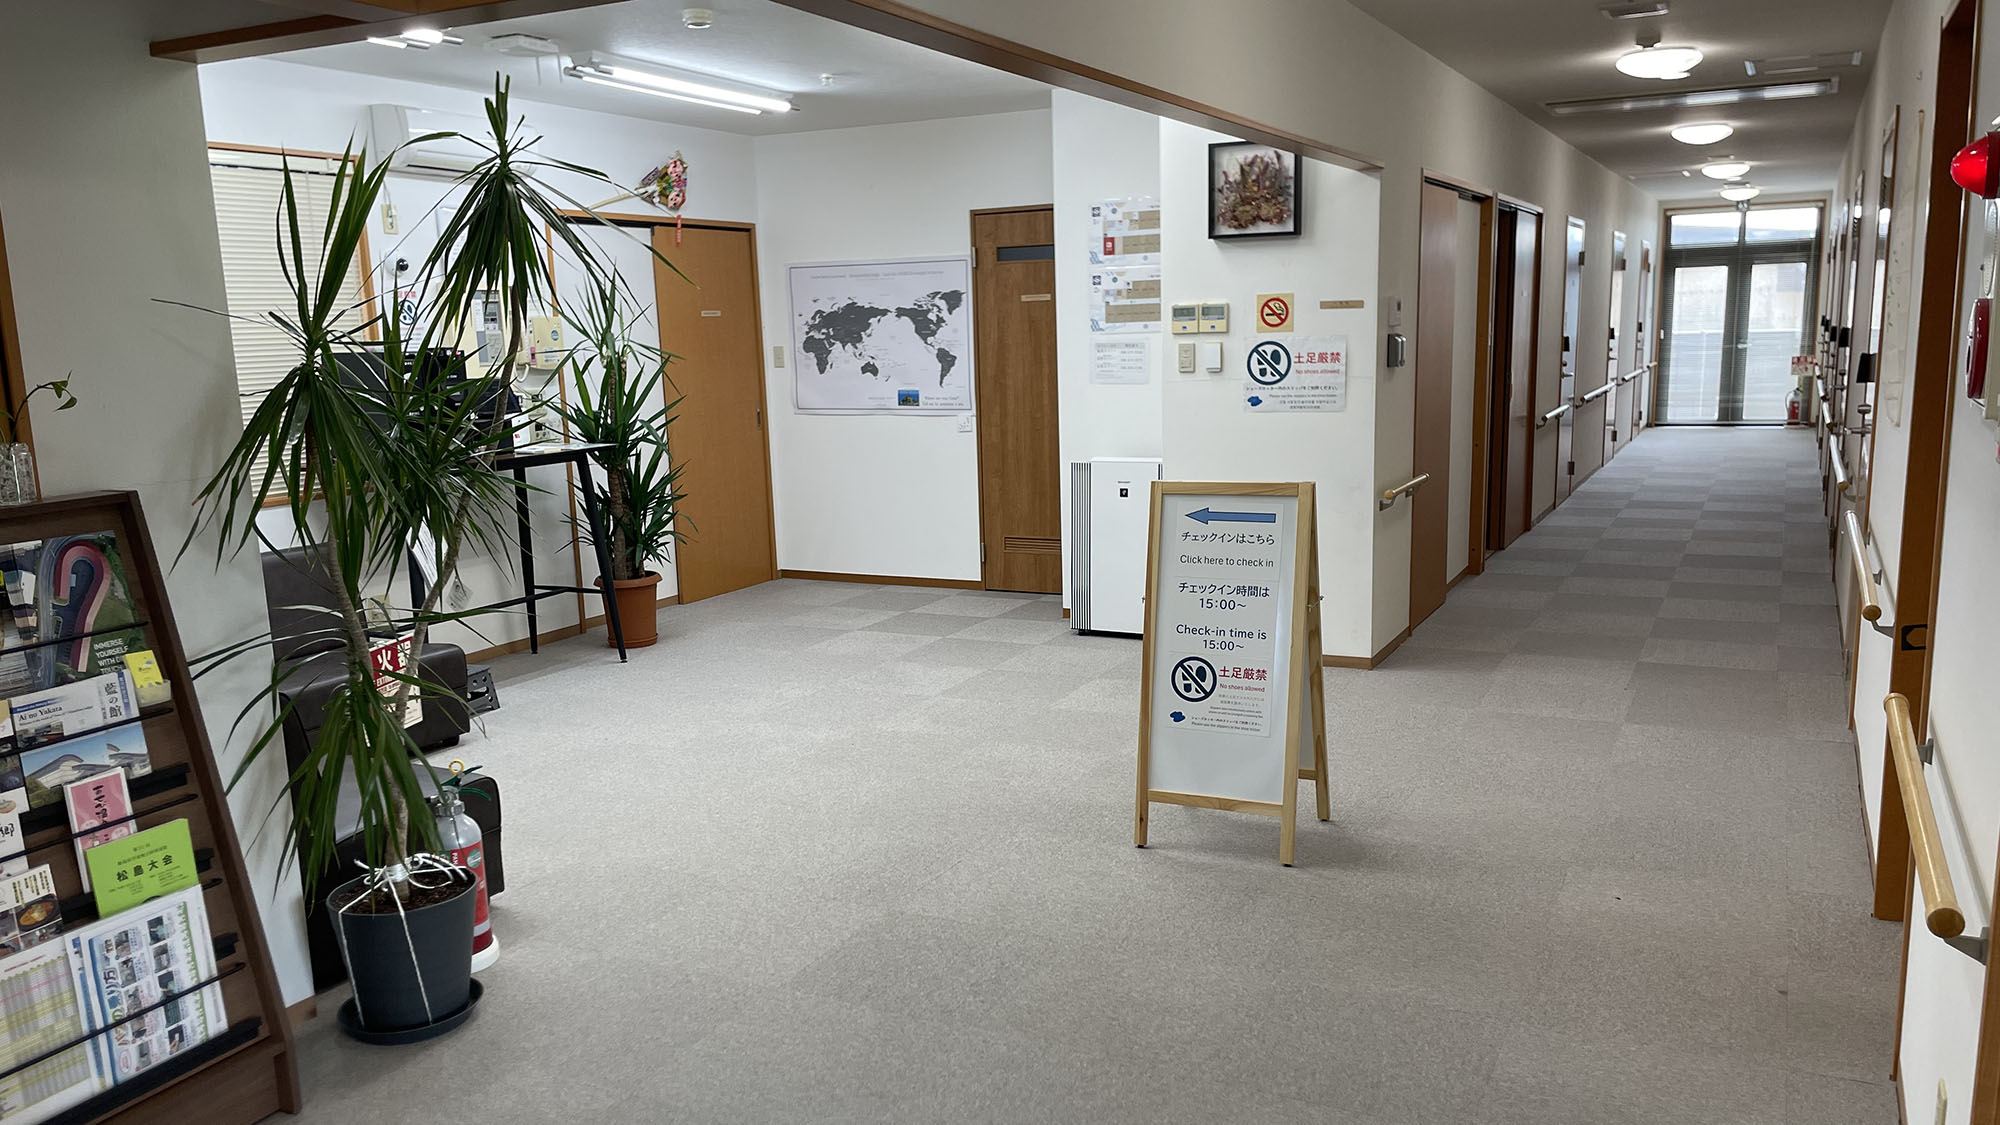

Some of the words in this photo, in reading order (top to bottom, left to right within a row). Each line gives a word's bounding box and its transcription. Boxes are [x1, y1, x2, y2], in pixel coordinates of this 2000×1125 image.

[1294, 352, 1341, 364] 土足厳禁
[1181, 532, 1275, 545] チェックインはこちら
[1179, 554, 1202, 564] Click
[1205, 556, 1224, 565] here
[1226, 558, 1235, 566] to
[1236, 558, 1264, 567] check
[1178, 582, 1270, 598] チェックイン時間は
[1176, 624, 1226, 637] Check-in
[1229, 628, 1254, 639] time
[1257, 629, 1267, 640] is
[93, 638, 124, 650] IMMERSE
[95, 645, 129, 658] YOURSELF
[97, 657, 115, 667] WITH
[1218, 666, 1268, 681] 土足厳禁
[104, 682, 123, 719] 藍の館
[17, 713, 27, 722] Ai
[39, 706, 63, 717] Yakata
[116, 854, 173, 882] 松島大会
